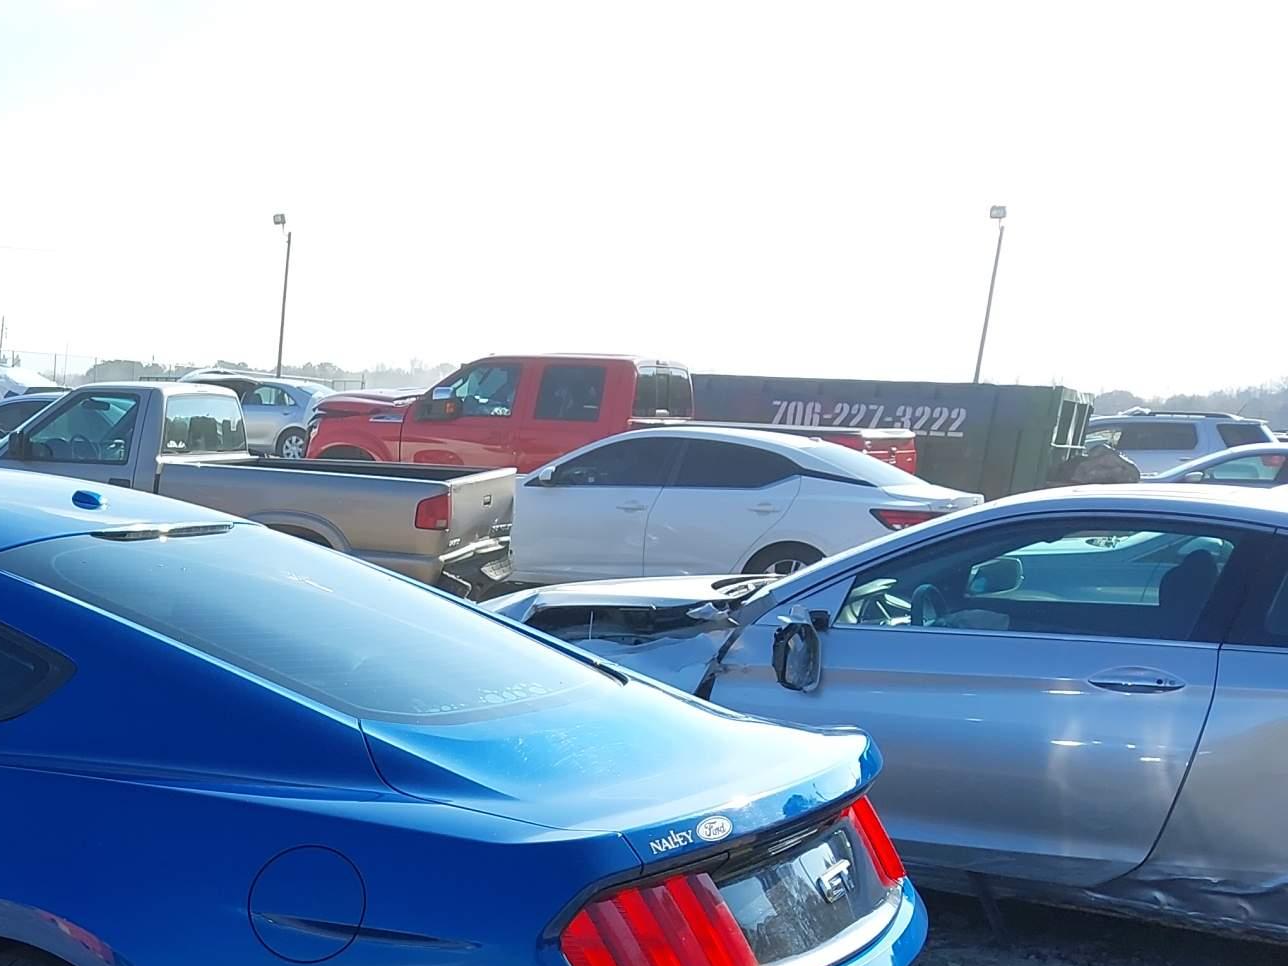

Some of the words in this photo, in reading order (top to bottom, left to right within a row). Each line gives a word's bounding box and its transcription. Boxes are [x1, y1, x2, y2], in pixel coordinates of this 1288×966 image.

[771, 400, 967, 437] 706-227-3222
[649, 829, 694, 854] NALLEY
[816, 857, 852, 905] GT
